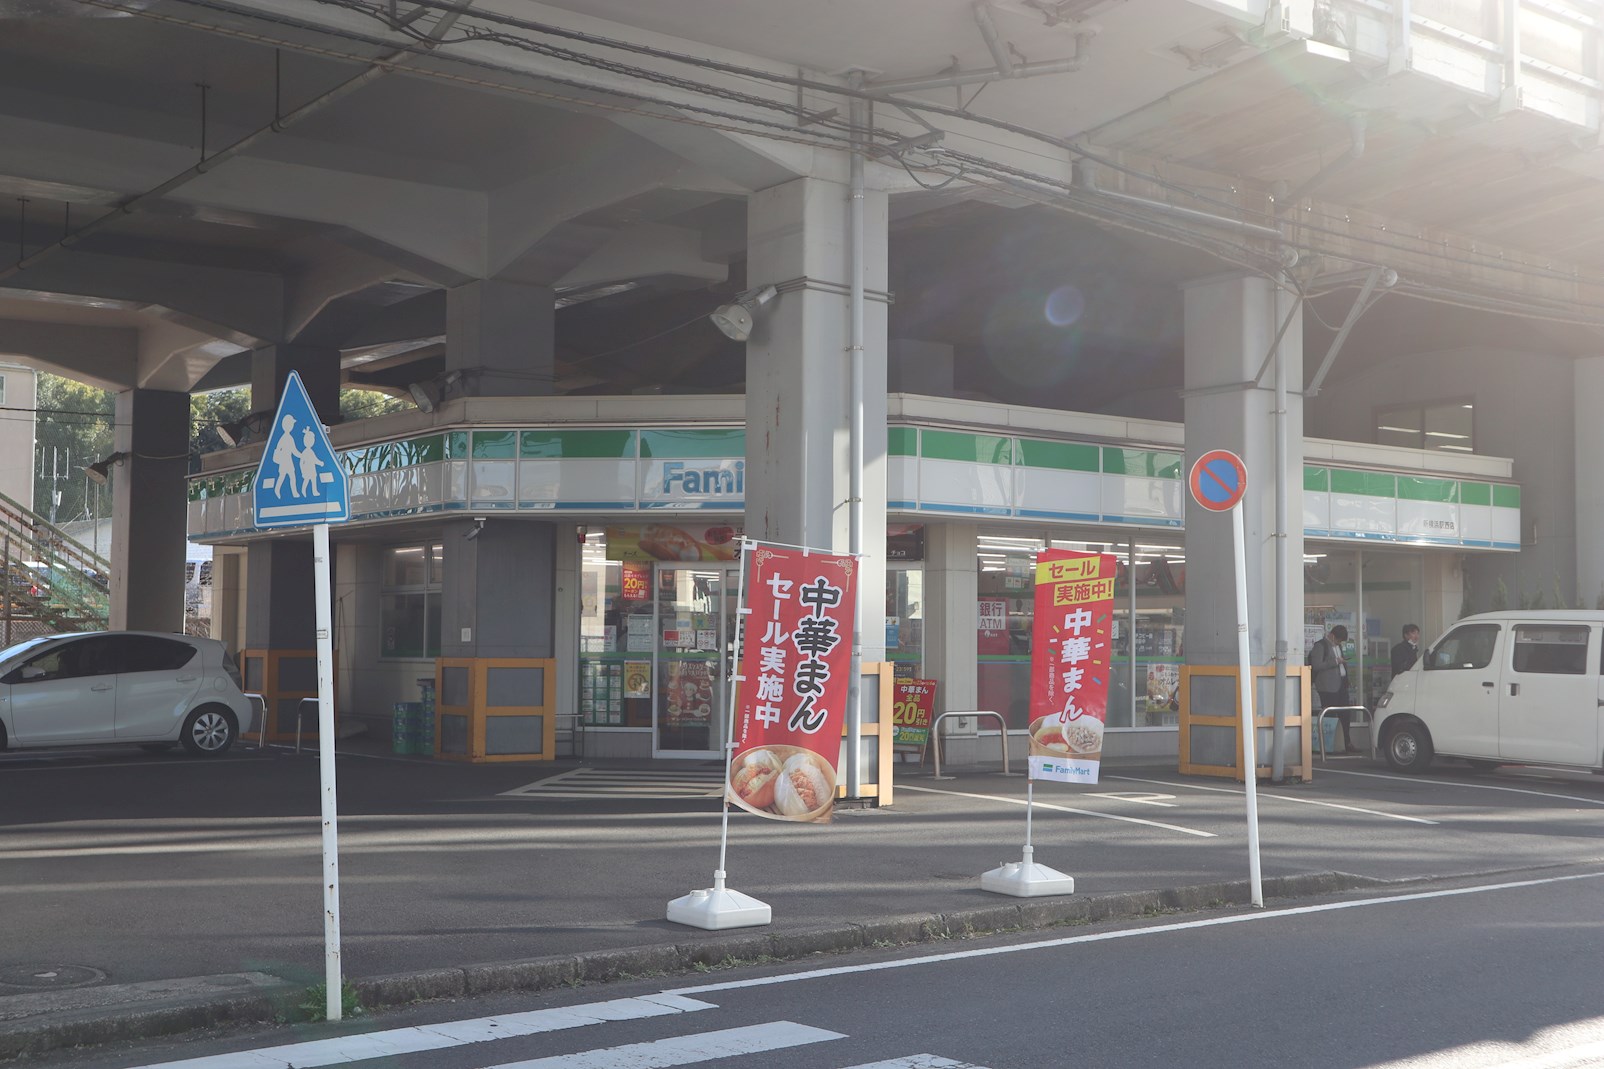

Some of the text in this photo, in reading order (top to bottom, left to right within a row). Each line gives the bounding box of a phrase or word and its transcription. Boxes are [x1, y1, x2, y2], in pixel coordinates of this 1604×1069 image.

[1048, 560, 1096, 579] セール
[1056, 580, 1113, 603] 実施中!
[979, 602, 1003, 617] 銀行
[979, 618, 1002, 629] ATM
[754, 572, 795, 730] セール実施中
[787, 575, 844, 734] 中華まん
[1060, 607, 1093, 723] 中華まん
[900, 685, 929, 694] 中華まん
[905, 694, 921, 702] 全品
[1055, 765, 1090, 776] FamilyMart
